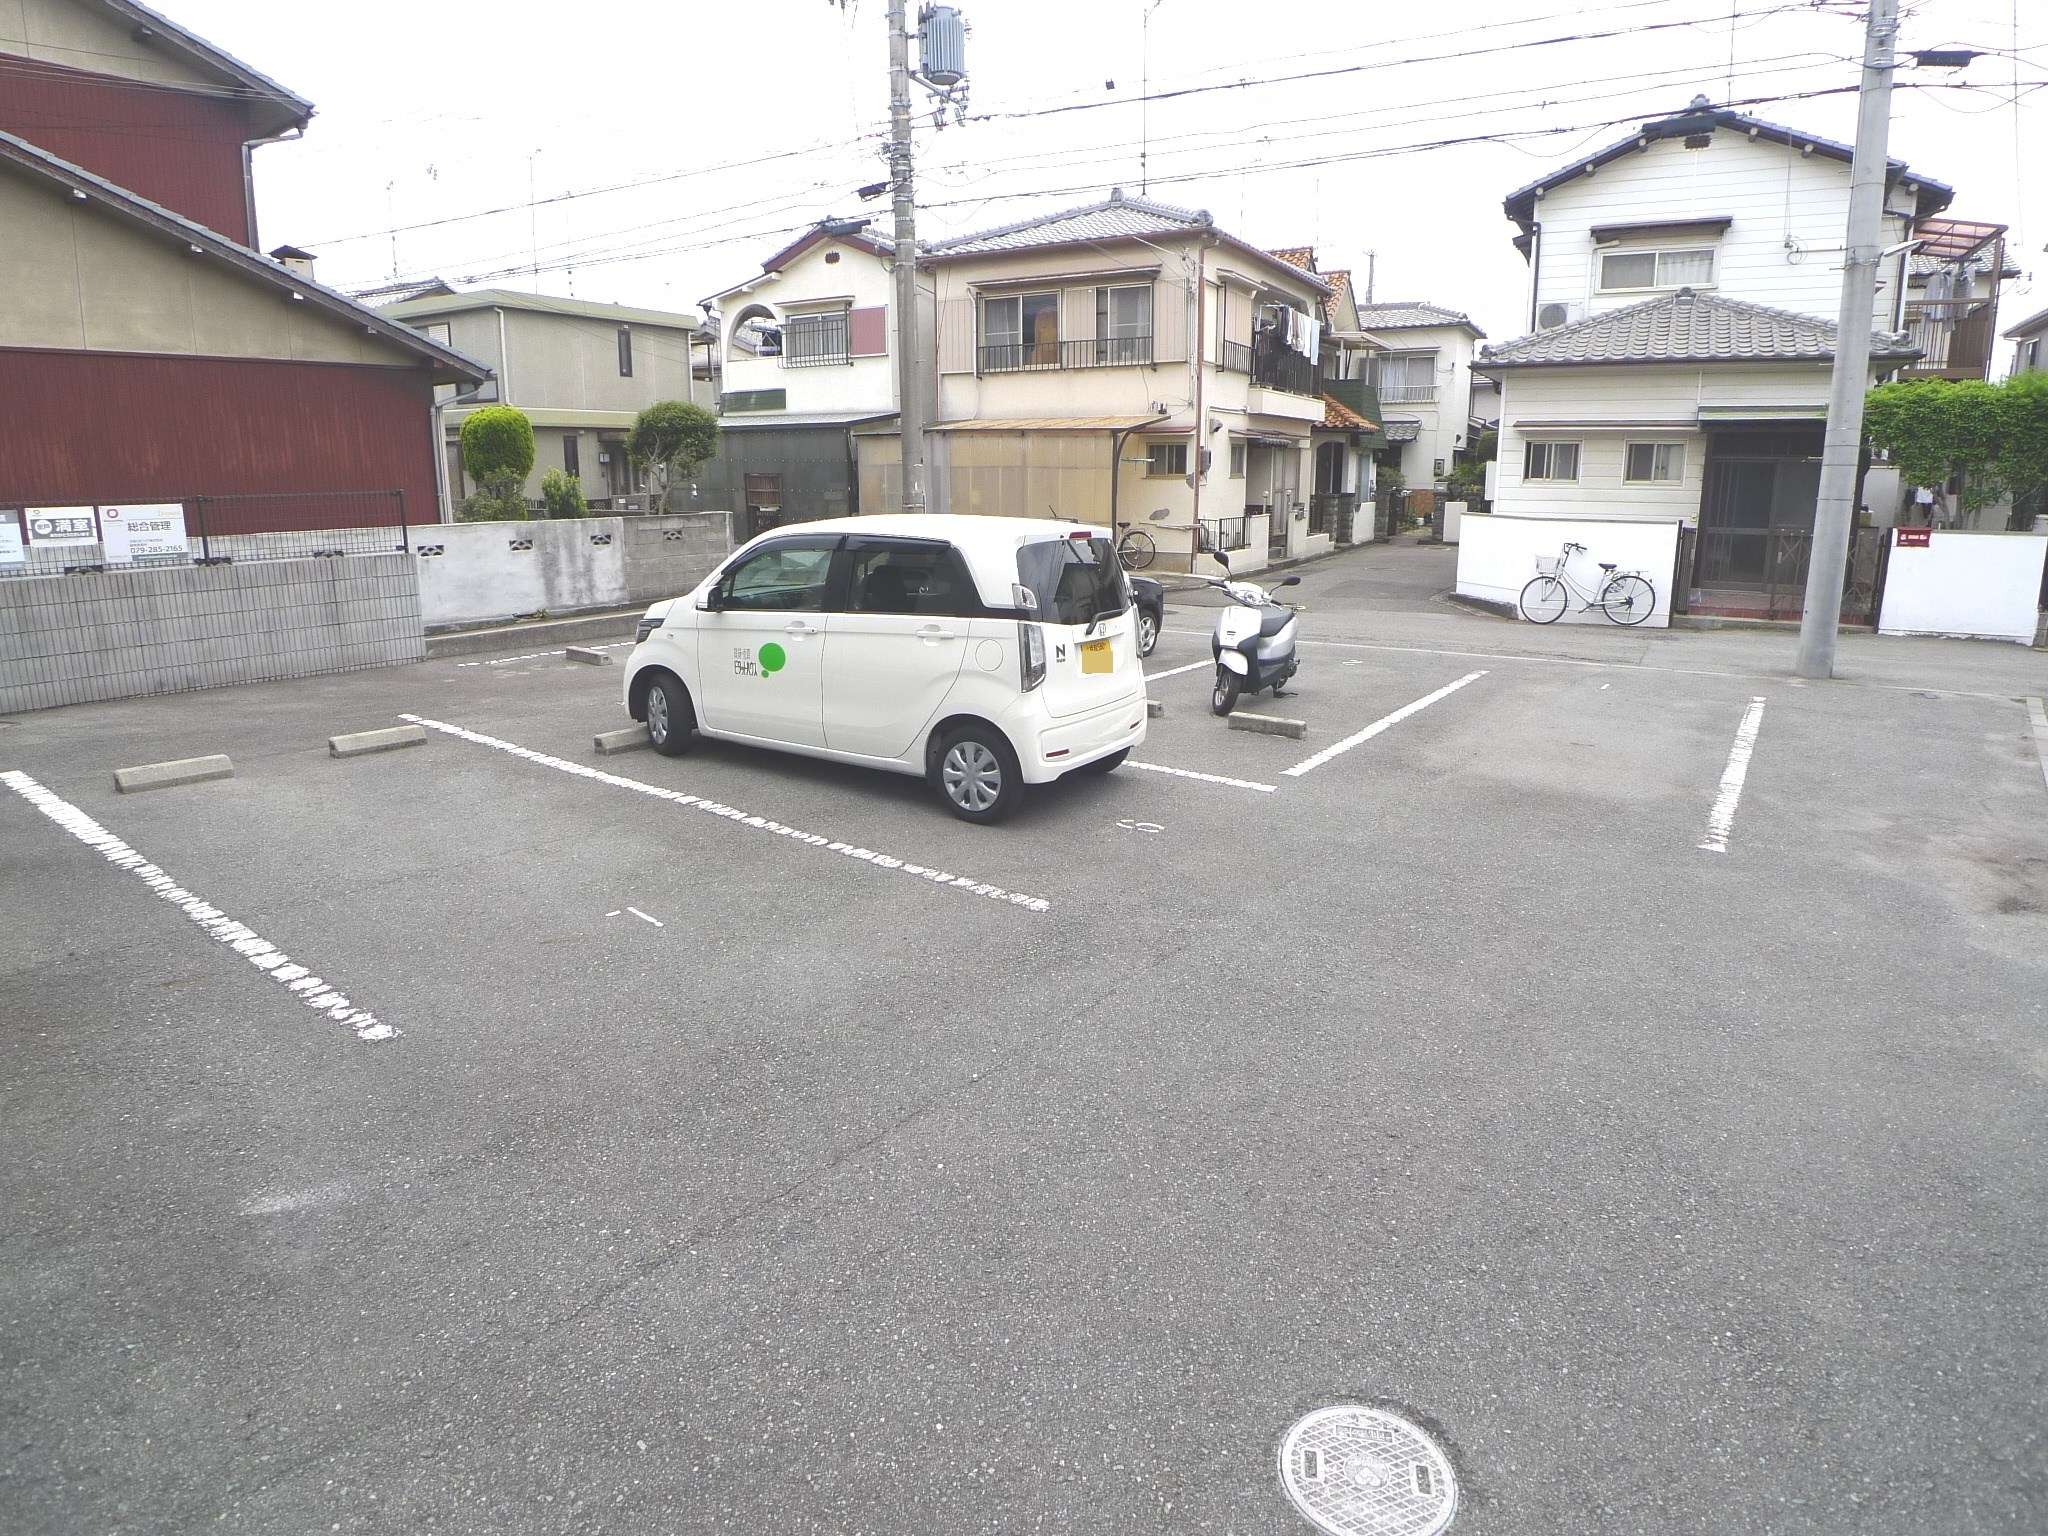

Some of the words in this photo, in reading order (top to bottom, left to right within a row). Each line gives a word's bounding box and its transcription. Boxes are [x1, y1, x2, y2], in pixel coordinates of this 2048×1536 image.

[55, 519, 90, 532] 満室
[127, 521, 173, 532] 総合管理
[130, 545, 183, 554] 079-285-2165
[1056, 644, 1066, 658] N
